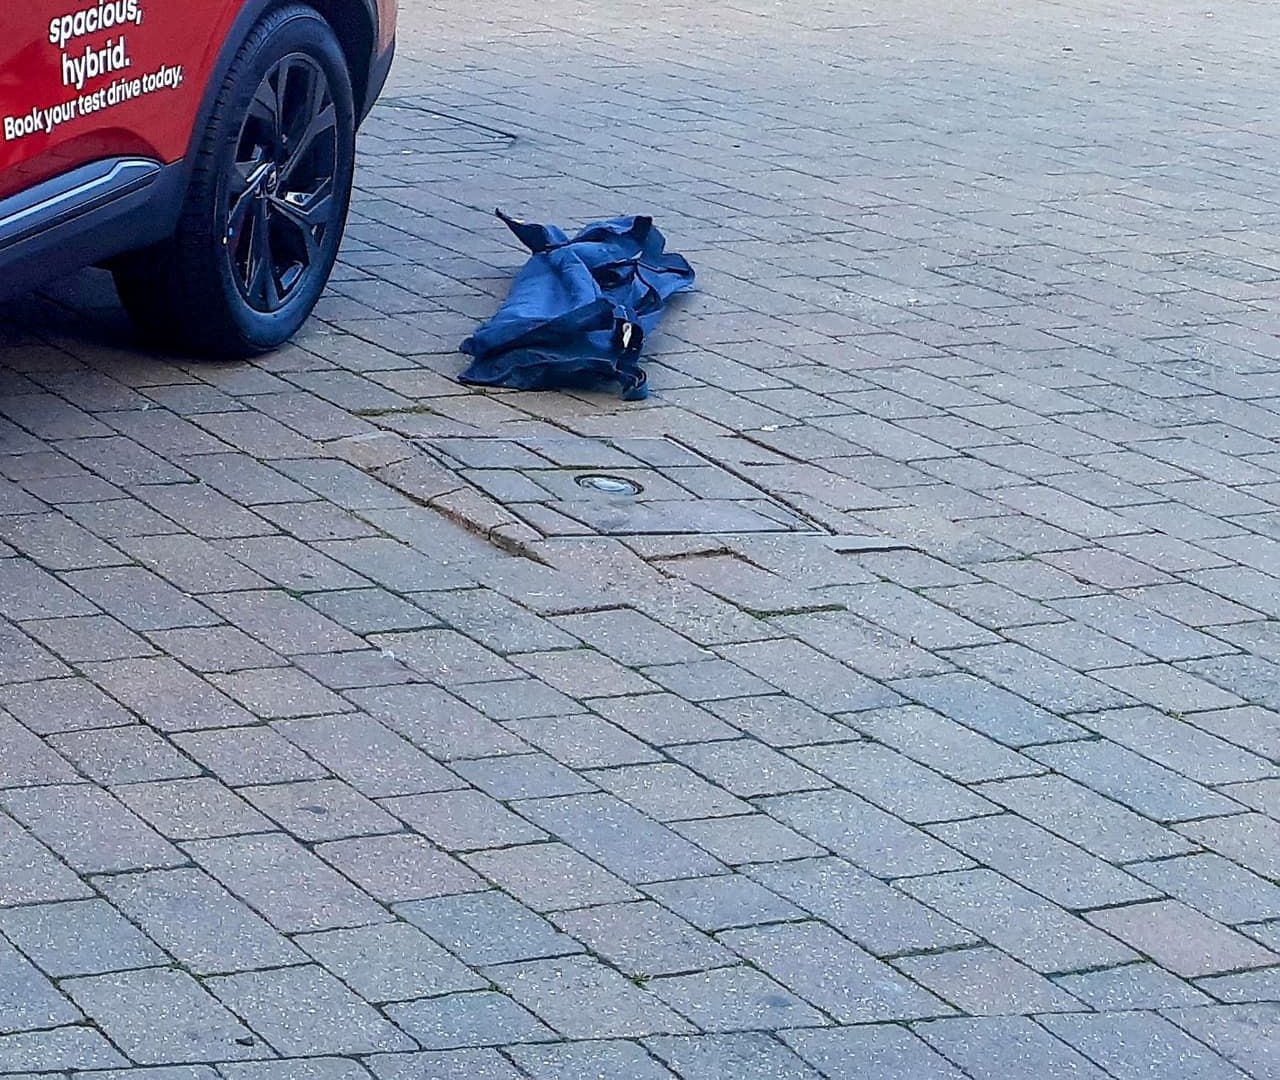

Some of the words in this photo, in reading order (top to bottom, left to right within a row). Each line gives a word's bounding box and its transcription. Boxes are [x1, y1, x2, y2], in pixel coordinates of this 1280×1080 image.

[62, 36, 130, 90] hybrid.
[3, 106, 44, 140] Book
[43, 98, 77, 133] your
[77, 89, 106, 116] test
[107, 77, 141, 105] drive
[142, 65, 183, 93] today.
